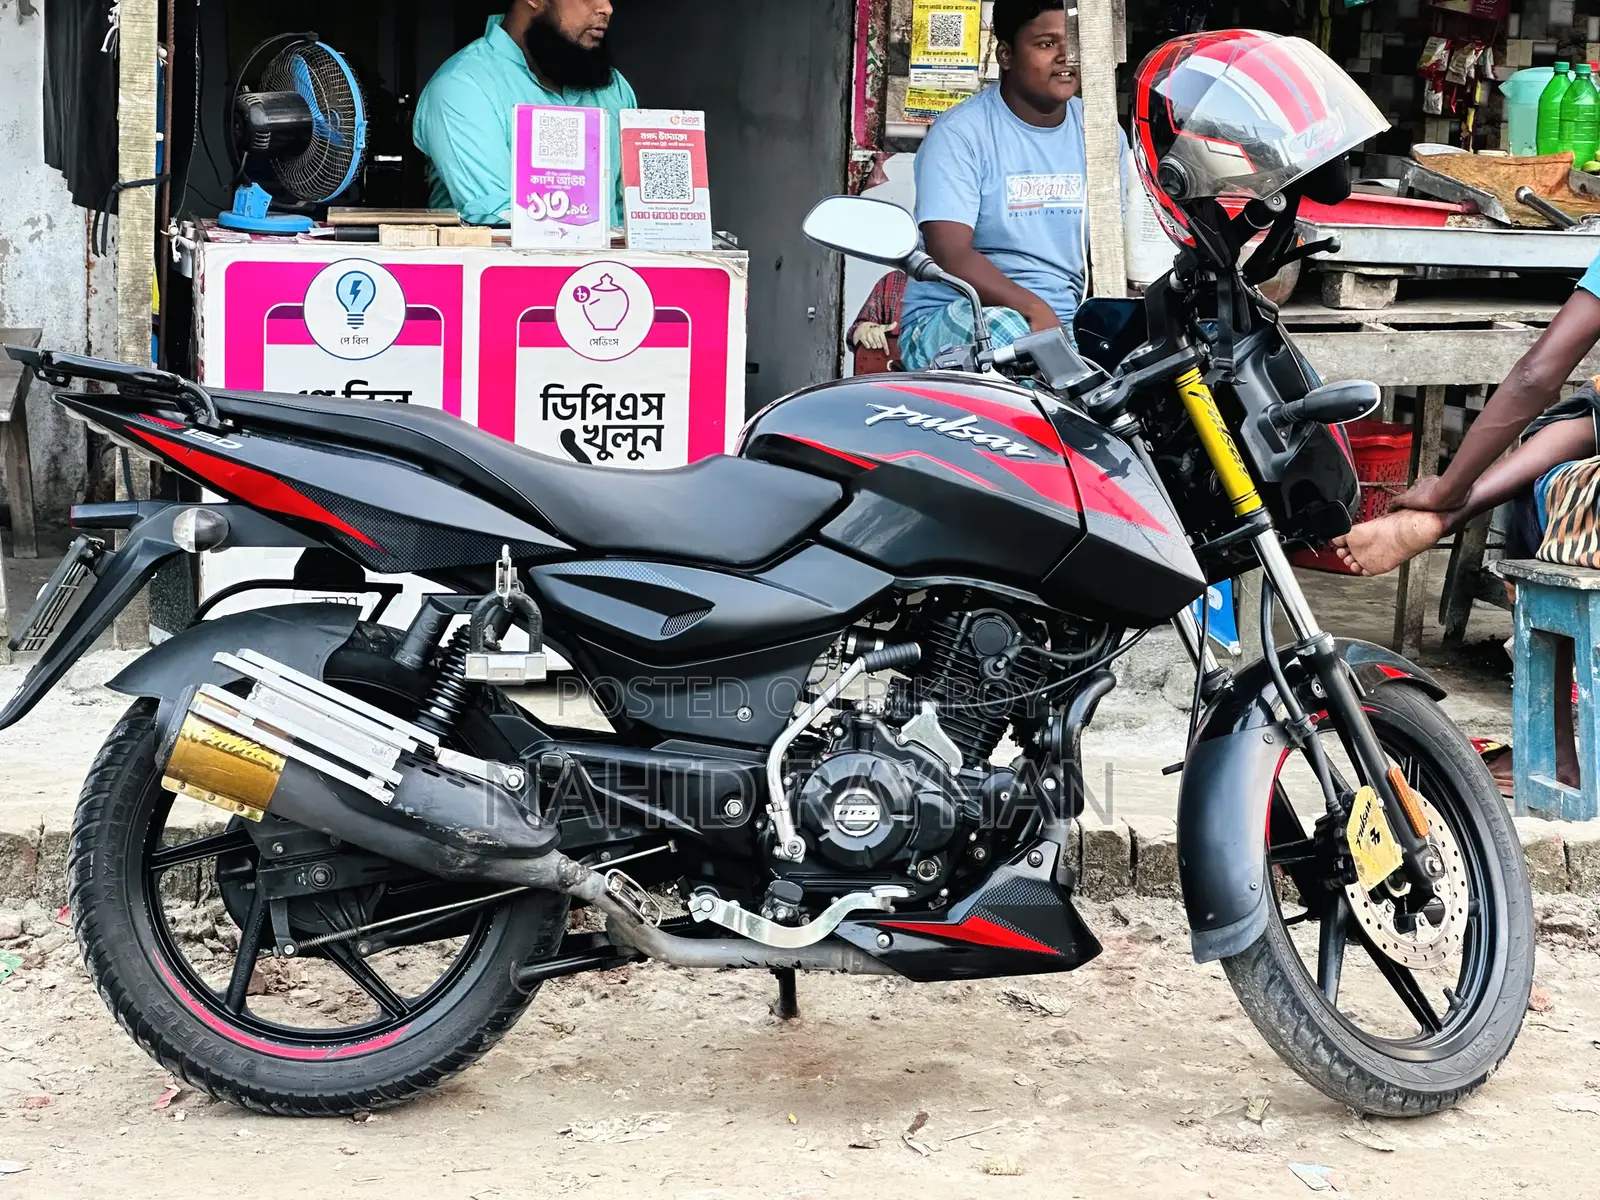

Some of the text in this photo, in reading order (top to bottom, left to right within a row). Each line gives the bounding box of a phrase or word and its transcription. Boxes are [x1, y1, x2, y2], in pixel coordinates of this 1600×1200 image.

[530, 174, 555, 185] ক্যাশ
[556, 174, 586, 187] আউট
[1017, 180, 1077, 198] Dreams
[340, 334, 369, 345] পে বিল
[589, 337, 619, 347] সেভিংস
[540, 383, 666, 421] ডিপিএস
[582, 424, 665, 461] খুলুন
